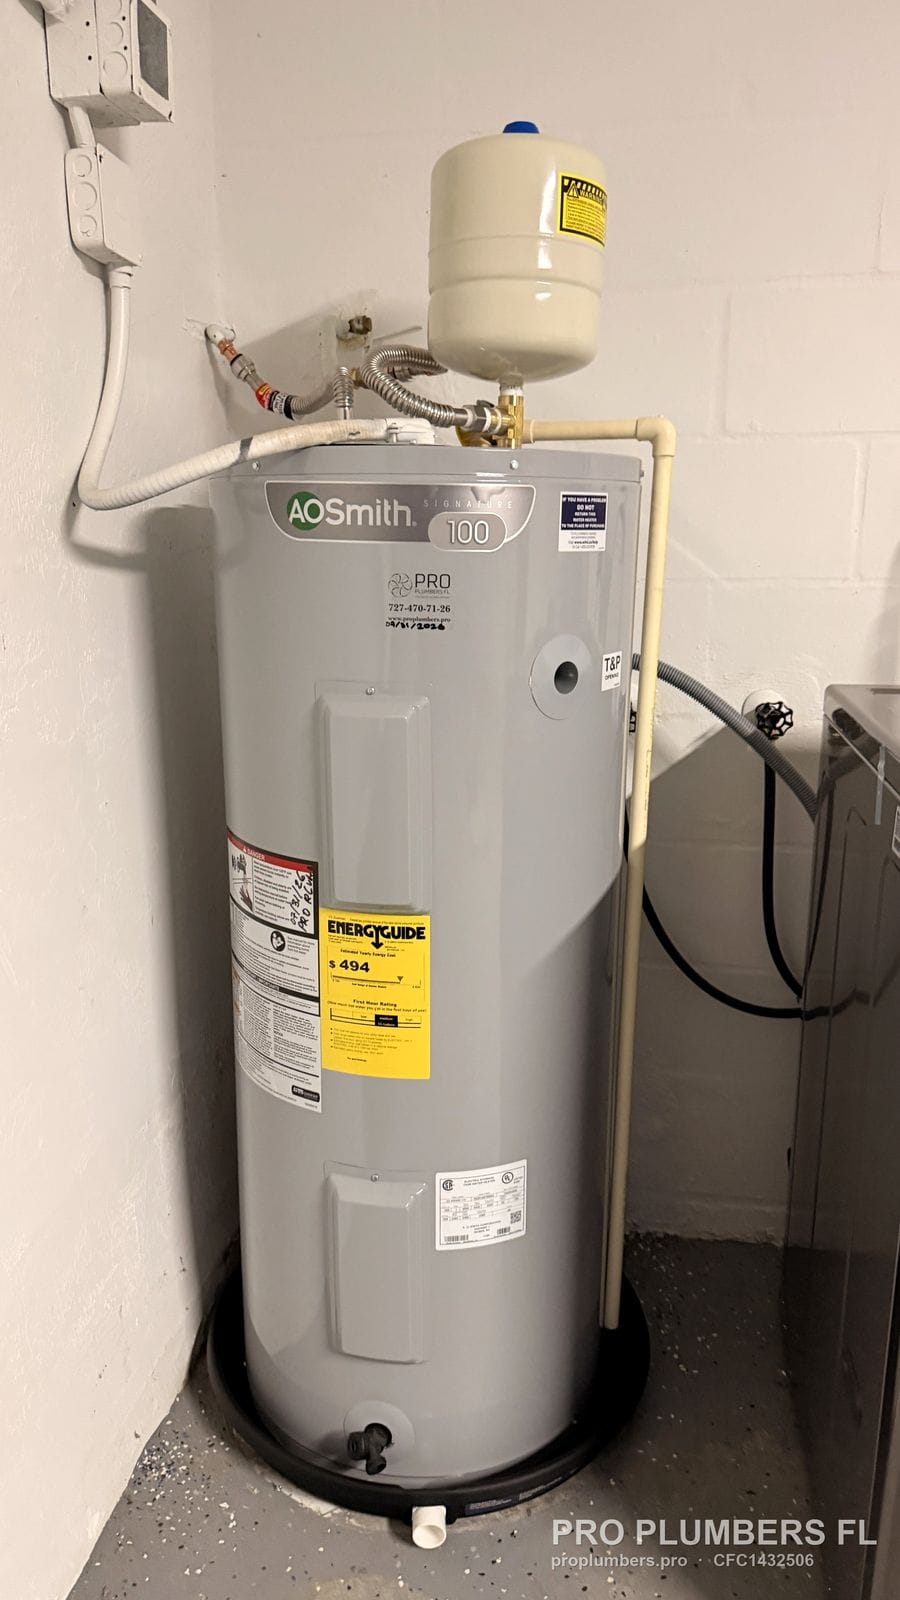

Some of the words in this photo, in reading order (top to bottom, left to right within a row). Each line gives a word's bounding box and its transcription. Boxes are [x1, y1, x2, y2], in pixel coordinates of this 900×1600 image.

[424, 500, 513, 508] SIGNATURE
[448, 520, 489, 544] 100
[415, 574, 450, 588] PRO
[388, 604, 451, 612] 727-470-71-26
[604, 656, 620, 672] T&P
[328, 920, 426, 941] ENERGYGUIDE
[329, 960, 335, 968] $
[339, 959, 370, 972] 494
